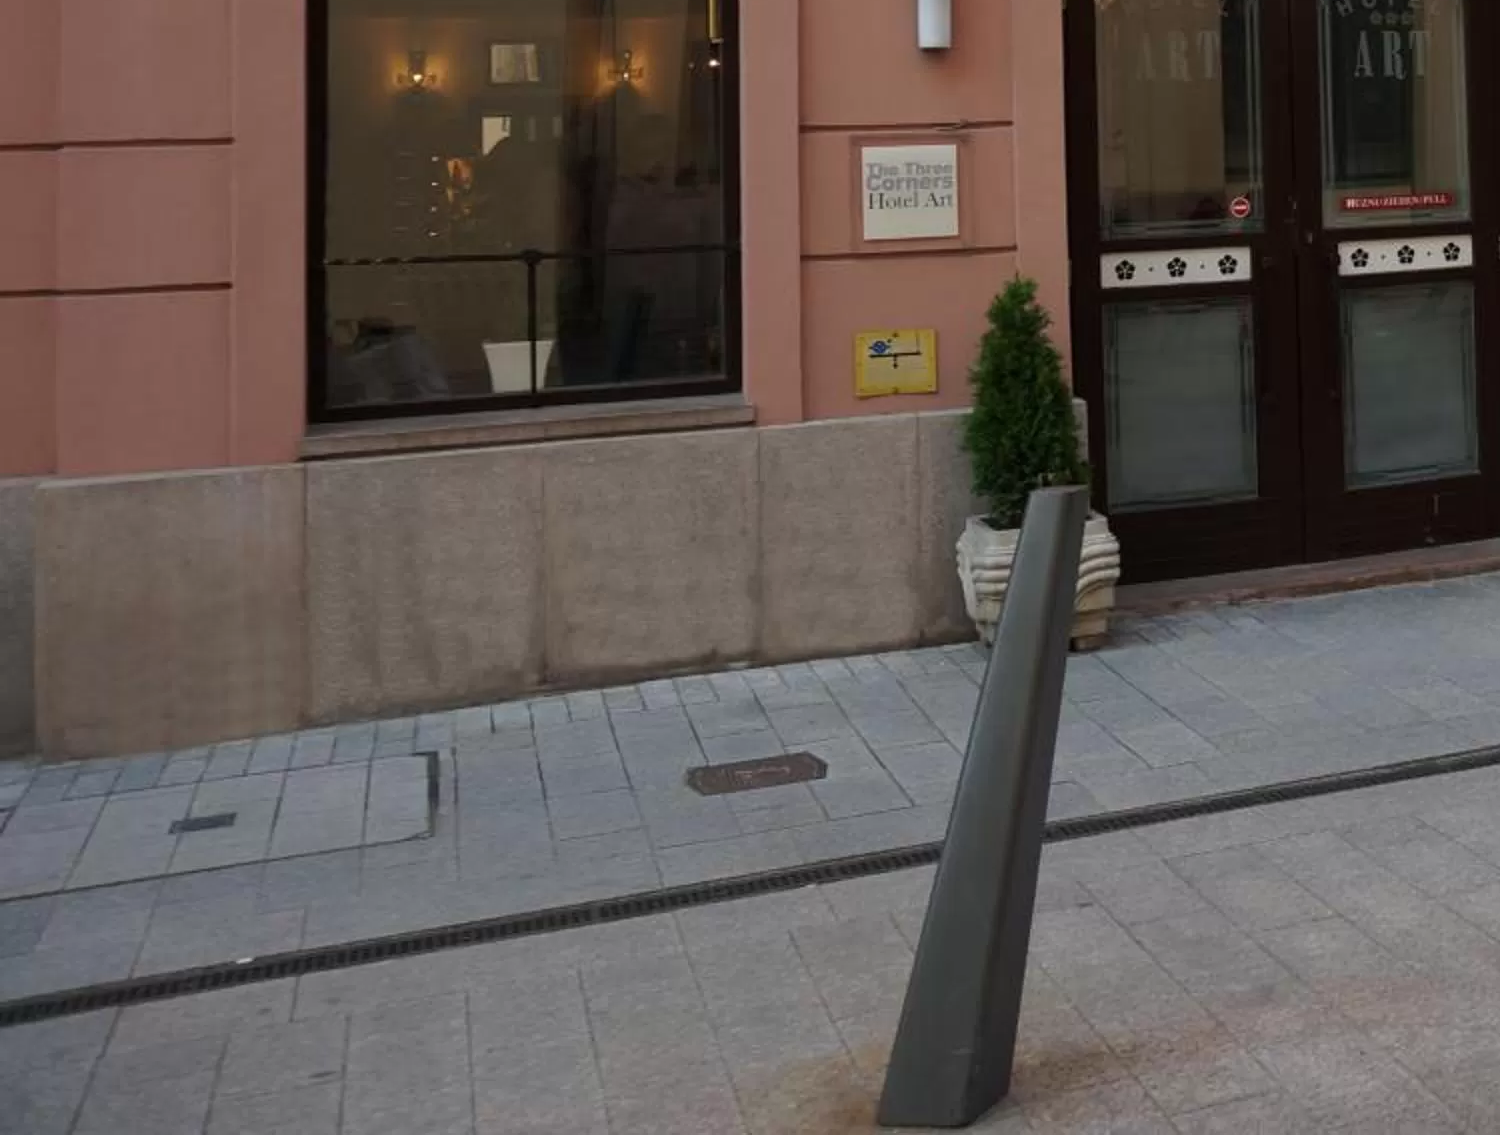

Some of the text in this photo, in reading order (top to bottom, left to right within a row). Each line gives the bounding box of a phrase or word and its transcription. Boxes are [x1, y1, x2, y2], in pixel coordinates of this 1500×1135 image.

[1353, 29, 1432, 81] ART
[868, 190, 953, 210] Hotel Art
